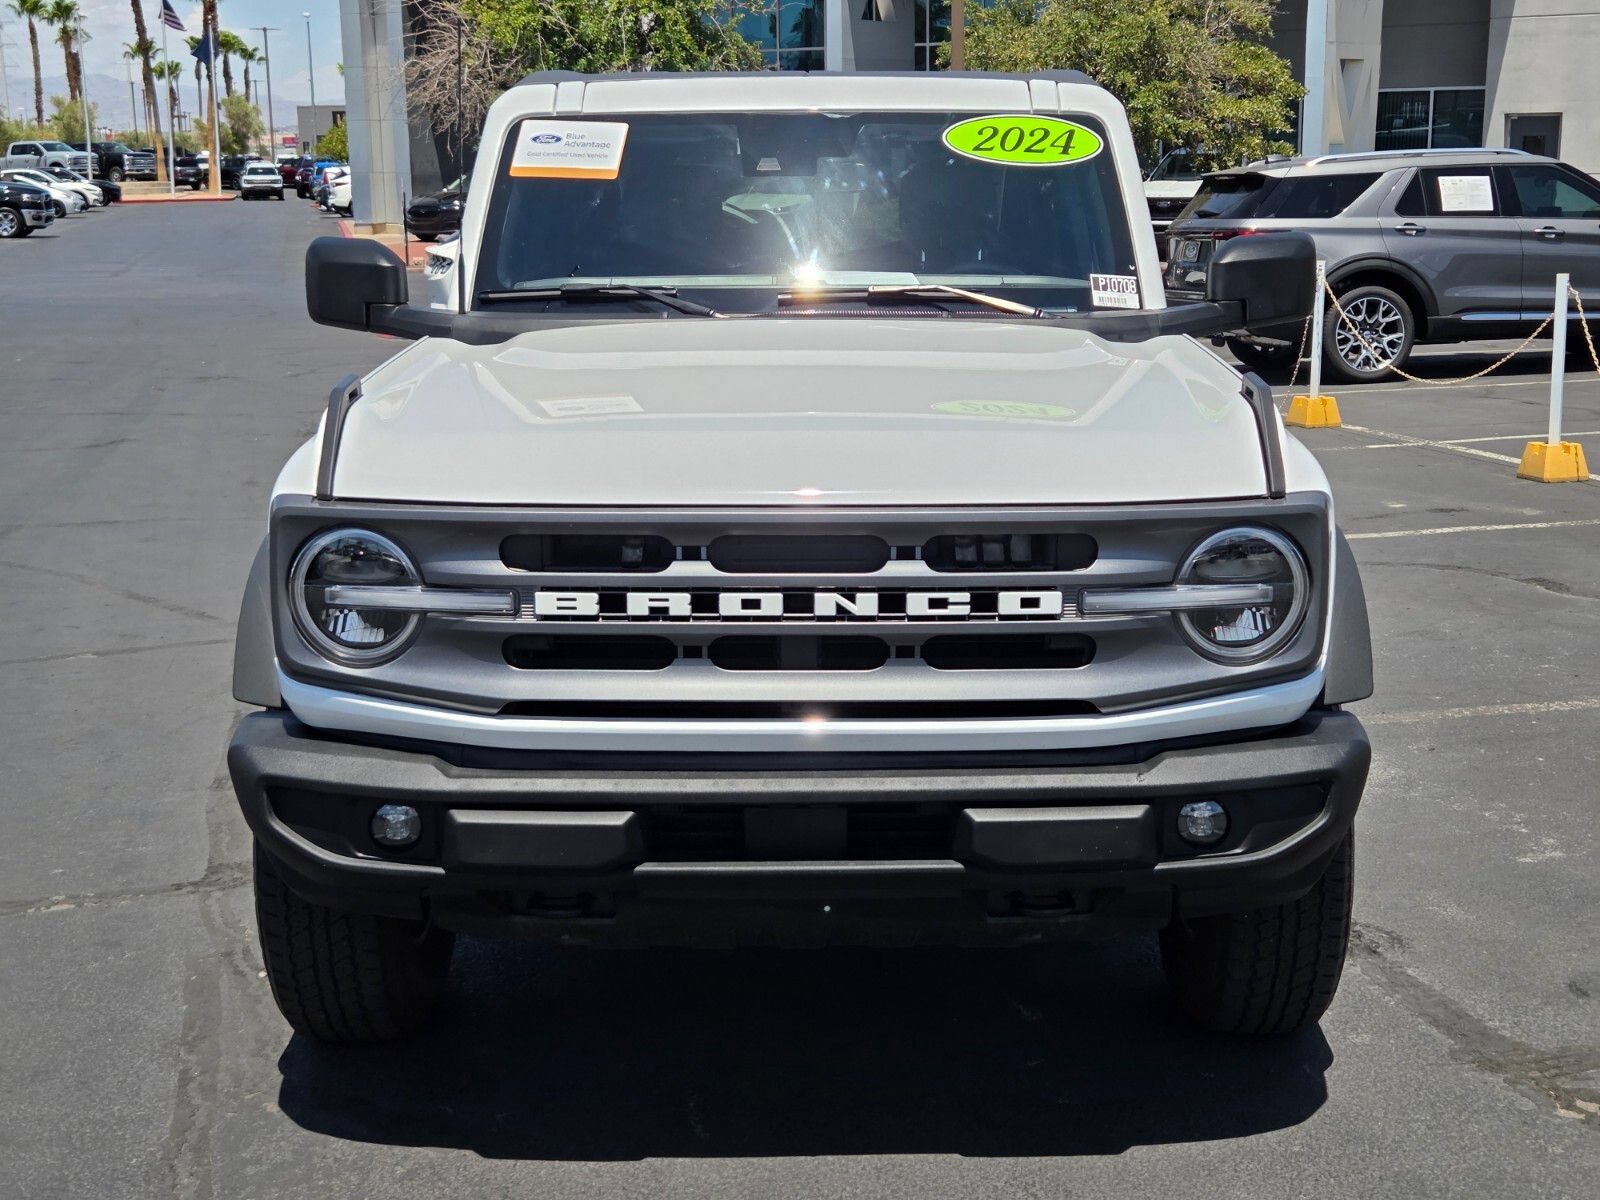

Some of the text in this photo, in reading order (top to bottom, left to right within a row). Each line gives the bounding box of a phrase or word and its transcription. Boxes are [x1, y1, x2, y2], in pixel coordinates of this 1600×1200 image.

[534, 133, 559, 144] Ford
[564, 140, 611, 149] Advantage
[972, 125, 1077, 156] 2024
[1098, 277, 1137, 294] P10708
[534, 591, 1063, 618] BRONCO
